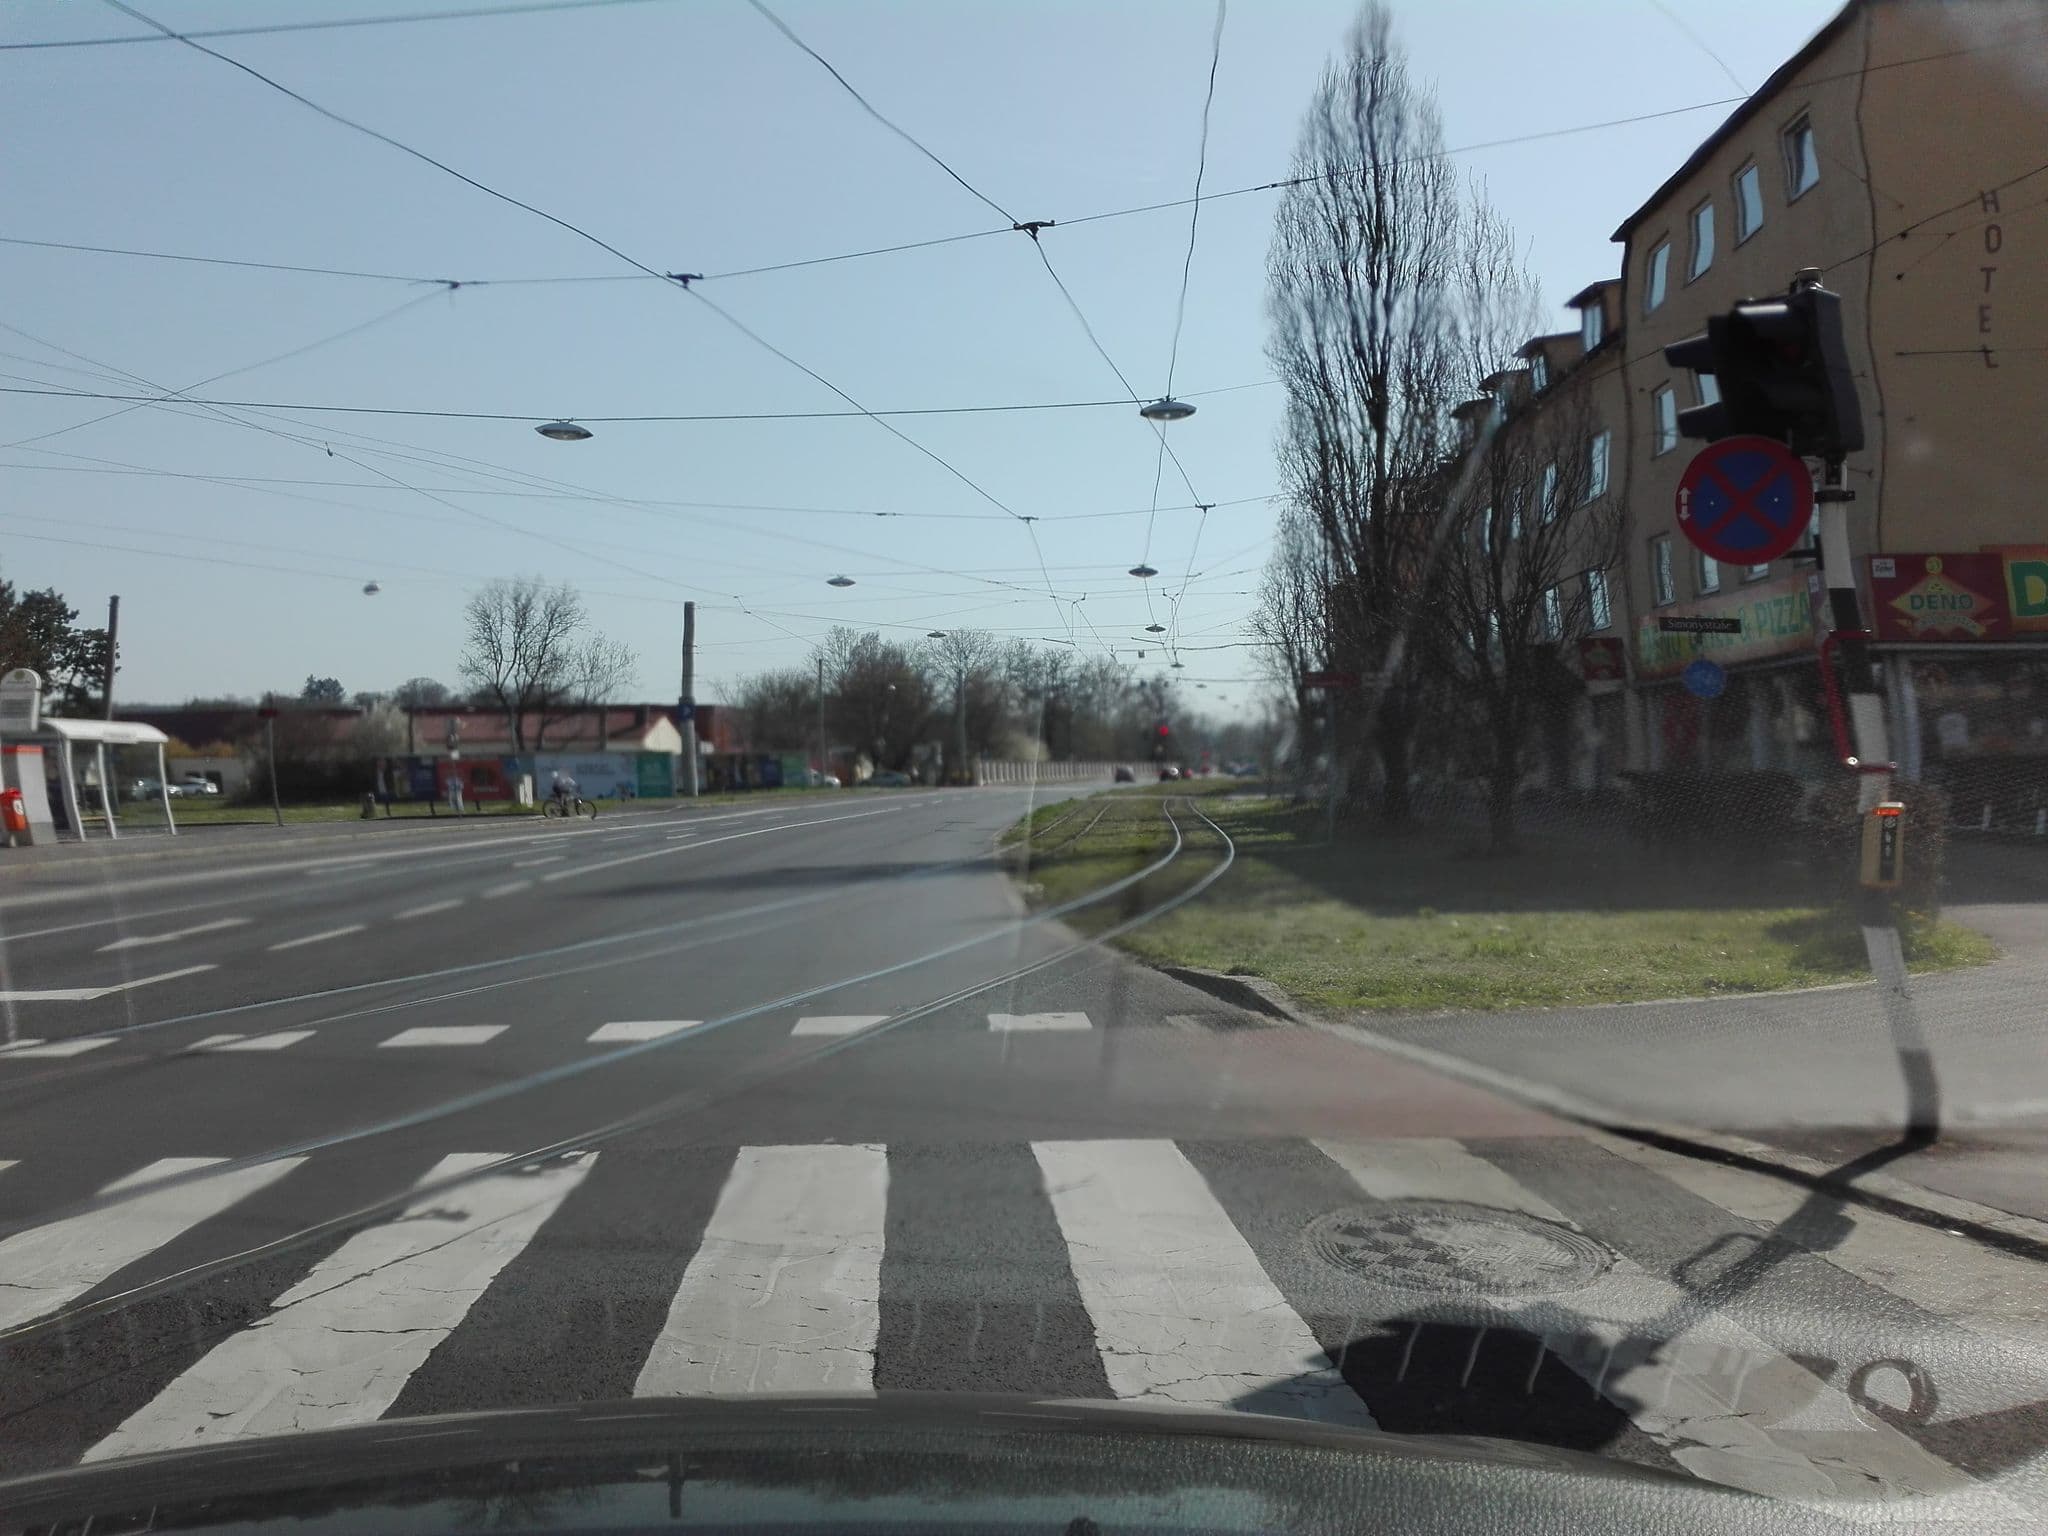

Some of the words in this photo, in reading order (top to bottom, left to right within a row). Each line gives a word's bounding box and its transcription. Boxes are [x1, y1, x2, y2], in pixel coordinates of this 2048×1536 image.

[1979, 190, 2002, 368] HOTEL
[1755, 591, 1811, 640] PIZZA
[1910, 594, 1973, 610] DENO
